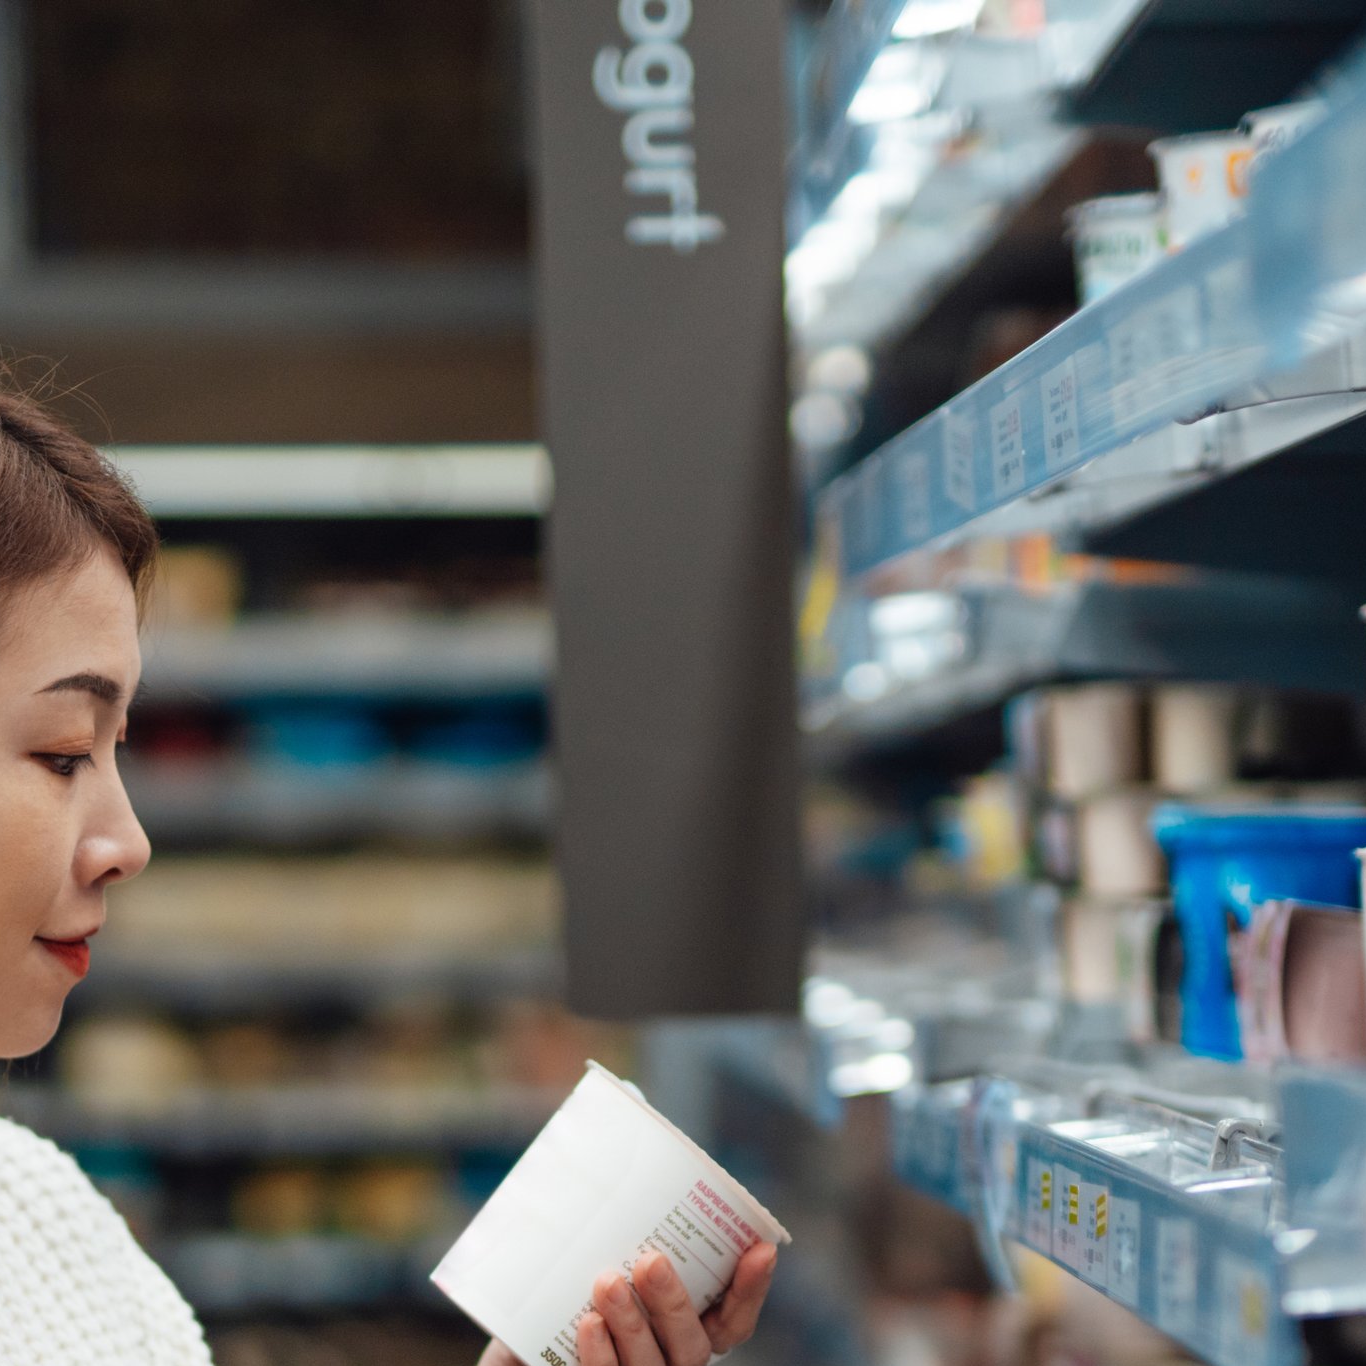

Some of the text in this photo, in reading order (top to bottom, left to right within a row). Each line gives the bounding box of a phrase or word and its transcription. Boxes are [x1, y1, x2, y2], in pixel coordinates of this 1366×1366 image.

[686, 1189, 714, 1220] TYPICAL
[695, 1179, 734, 1219] RASPBERRY
[653, 1227, 688, 1264] Typical Values
[664, 1213, 692, 1241] Serve size
[672, 1205, 725, 1256] Servings per container
